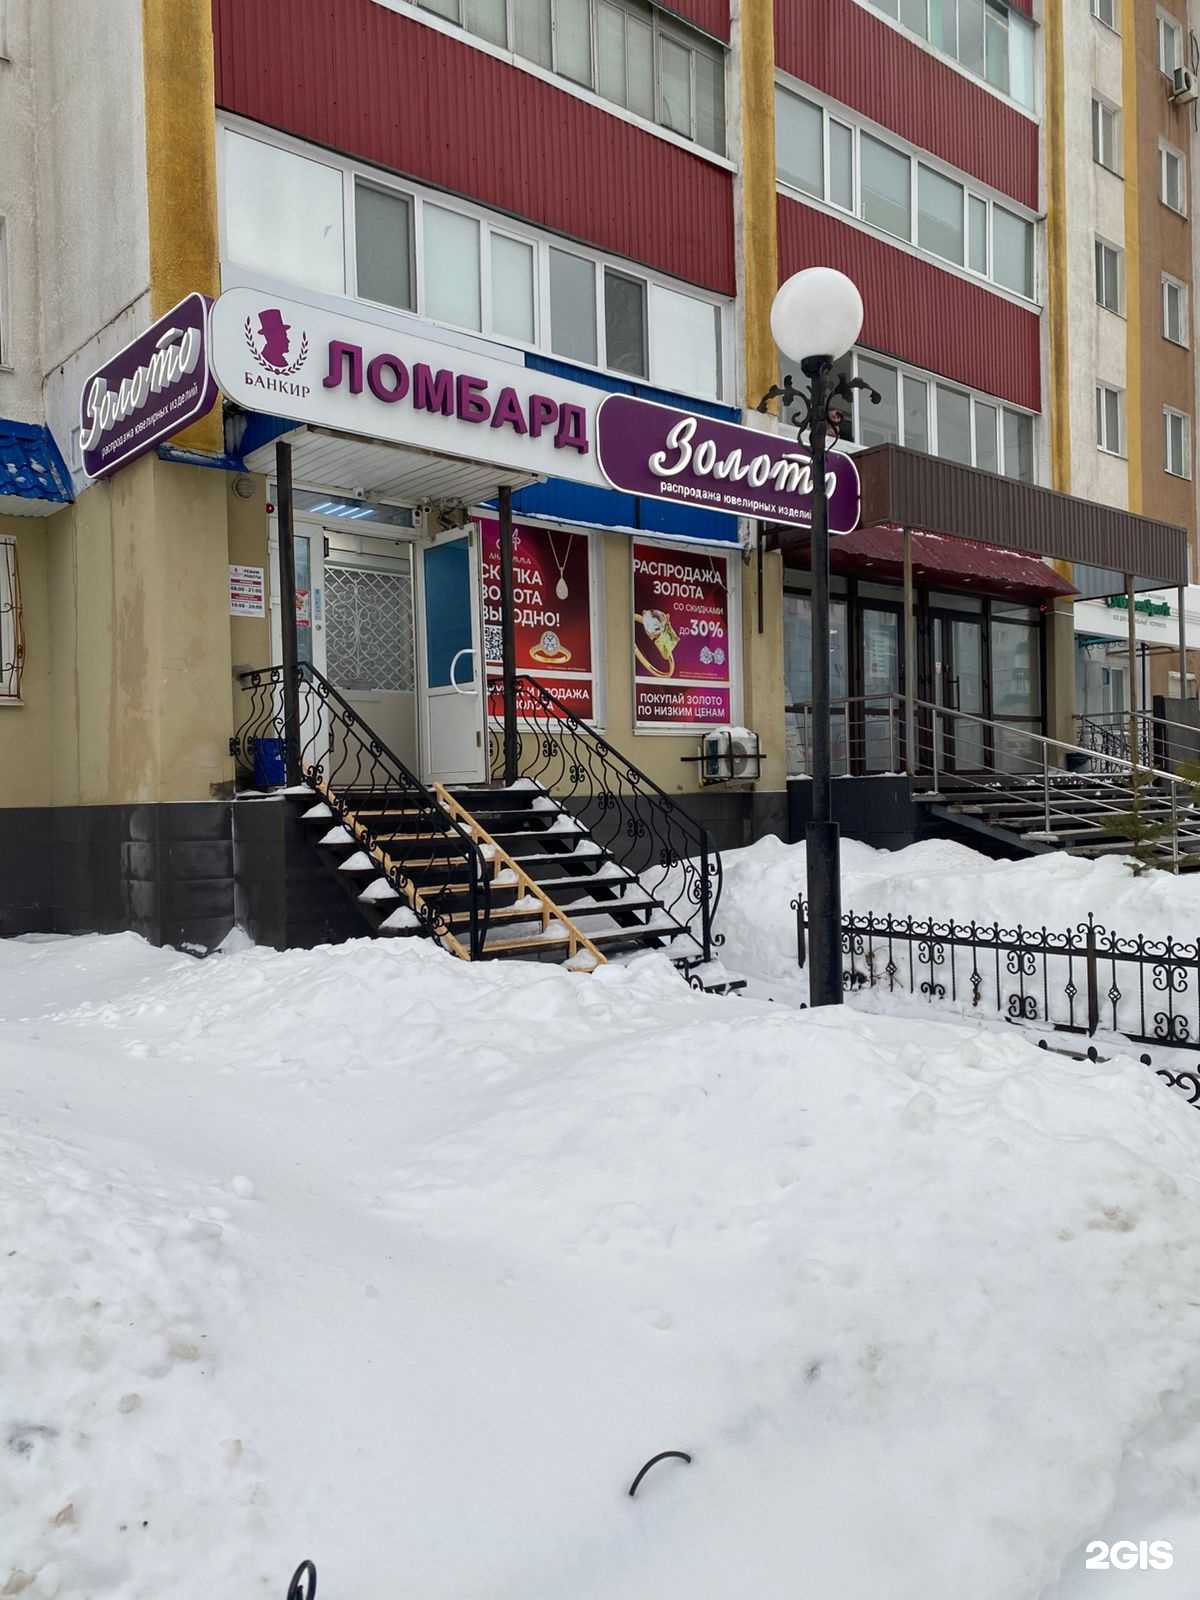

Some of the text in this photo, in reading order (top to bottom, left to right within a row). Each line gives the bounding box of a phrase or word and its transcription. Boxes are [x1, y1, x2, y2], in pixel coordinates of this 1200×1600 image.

[79, 327, 200, 451] Золото
[244, 372, 311, 398] БАНКИР
[322, 339, 589, 455] ЛОМБАРД
[660, 481, 813, 521] распродажа ювелирных издели
[481, 563, 543, 586] СКПКА
[632, 559, 722, 584] РАСПРОДАЖА
[482, 584, 543, 606] ЗООТА
[653, 580, 704, 600] ЗОЛОТА
[483, 604, 560, 628] ВЫОДНО!
[690, 619, 724, 638] 30%
[640, 693, 722, 706] ПОКУПАЙ ЗОЛОТО
[638, 705, 725, 719] ПО НИЗКИМ ЦЕНАМ
